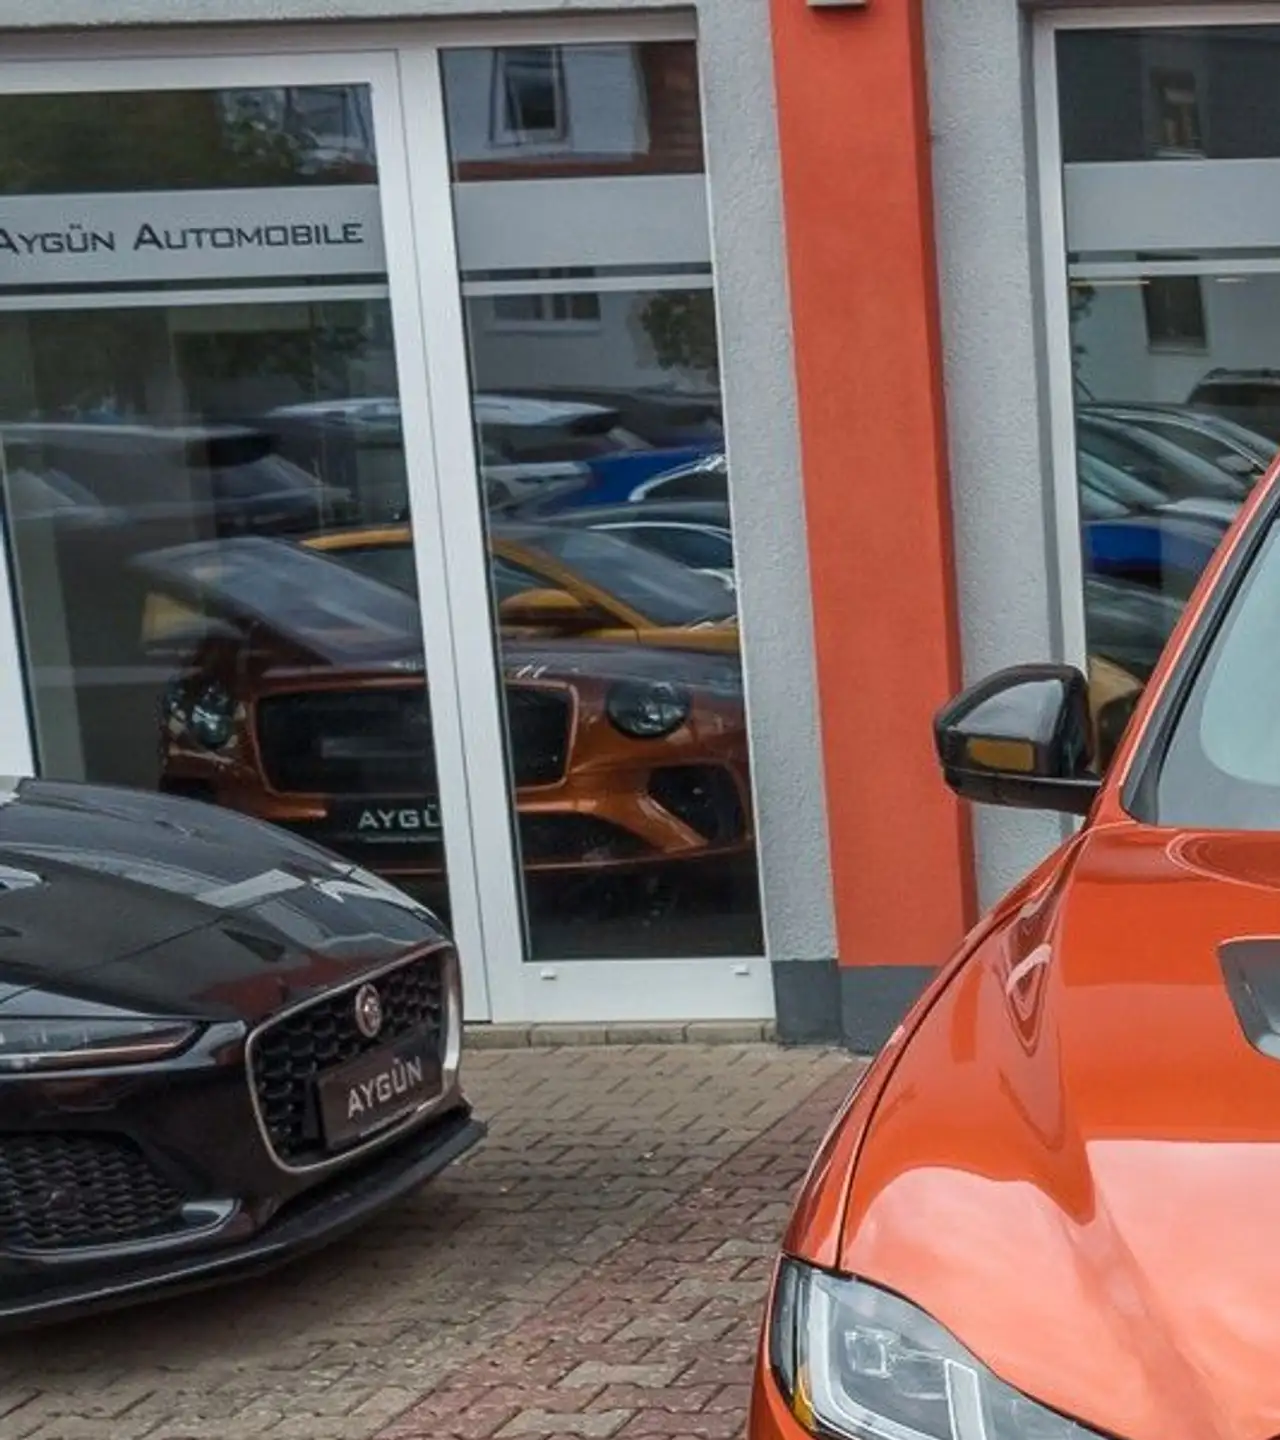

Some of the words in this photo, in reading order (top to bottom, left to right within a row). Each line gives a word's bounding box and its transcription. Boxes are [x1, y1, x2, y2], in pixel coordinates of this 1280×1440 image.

[133, 222, 365, 251] AUTOMOBILE
[358, 803, 442, 829] AYGÜ
[348, 1055, 422, 1119] AYGÜN
